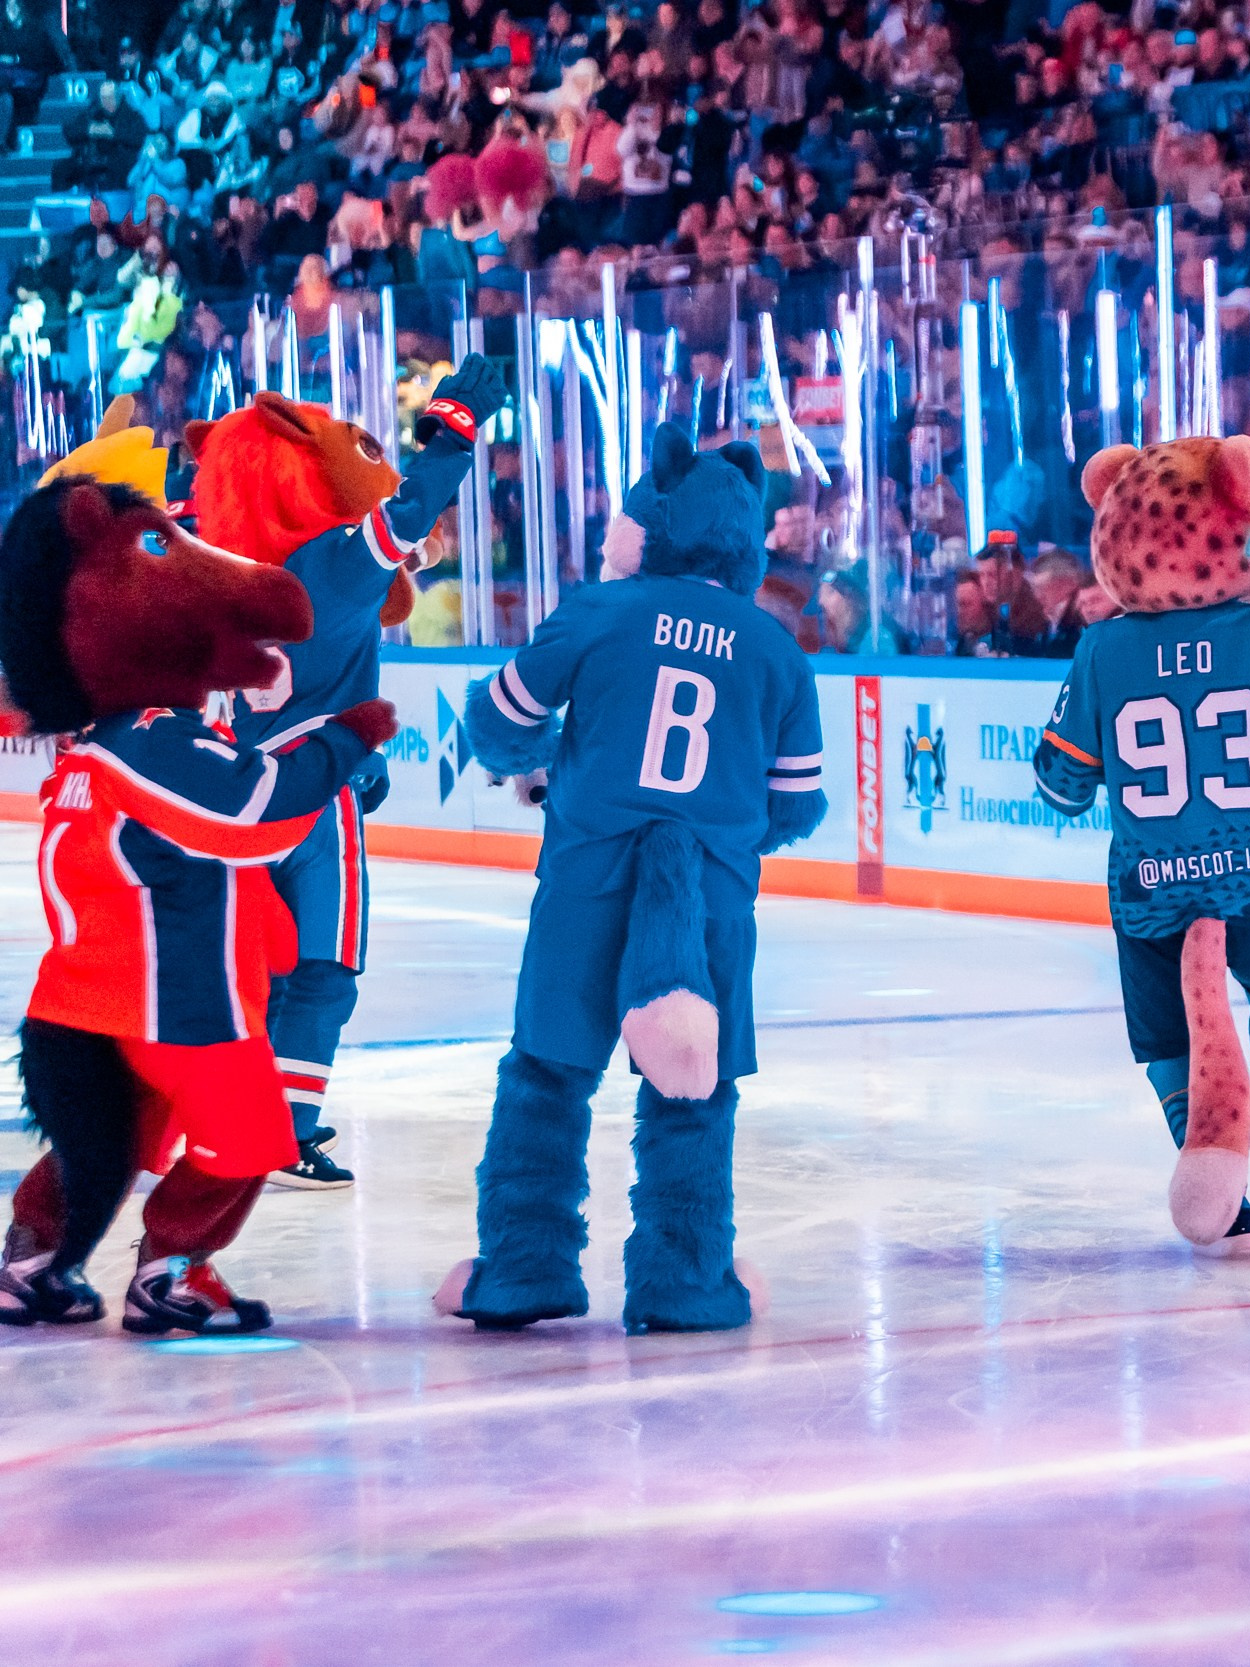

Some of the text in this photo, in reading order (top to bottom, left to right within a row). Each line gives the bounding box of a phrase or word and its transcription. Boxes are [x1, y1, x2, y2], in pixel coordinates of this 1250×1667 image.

[654, 613, 736, 661] ВОЛК
[1157, 640, 1213, 678] LEO
[980, 724, 1047, 762] ПРАВ
[860, 684, 879, 854] FONBET
